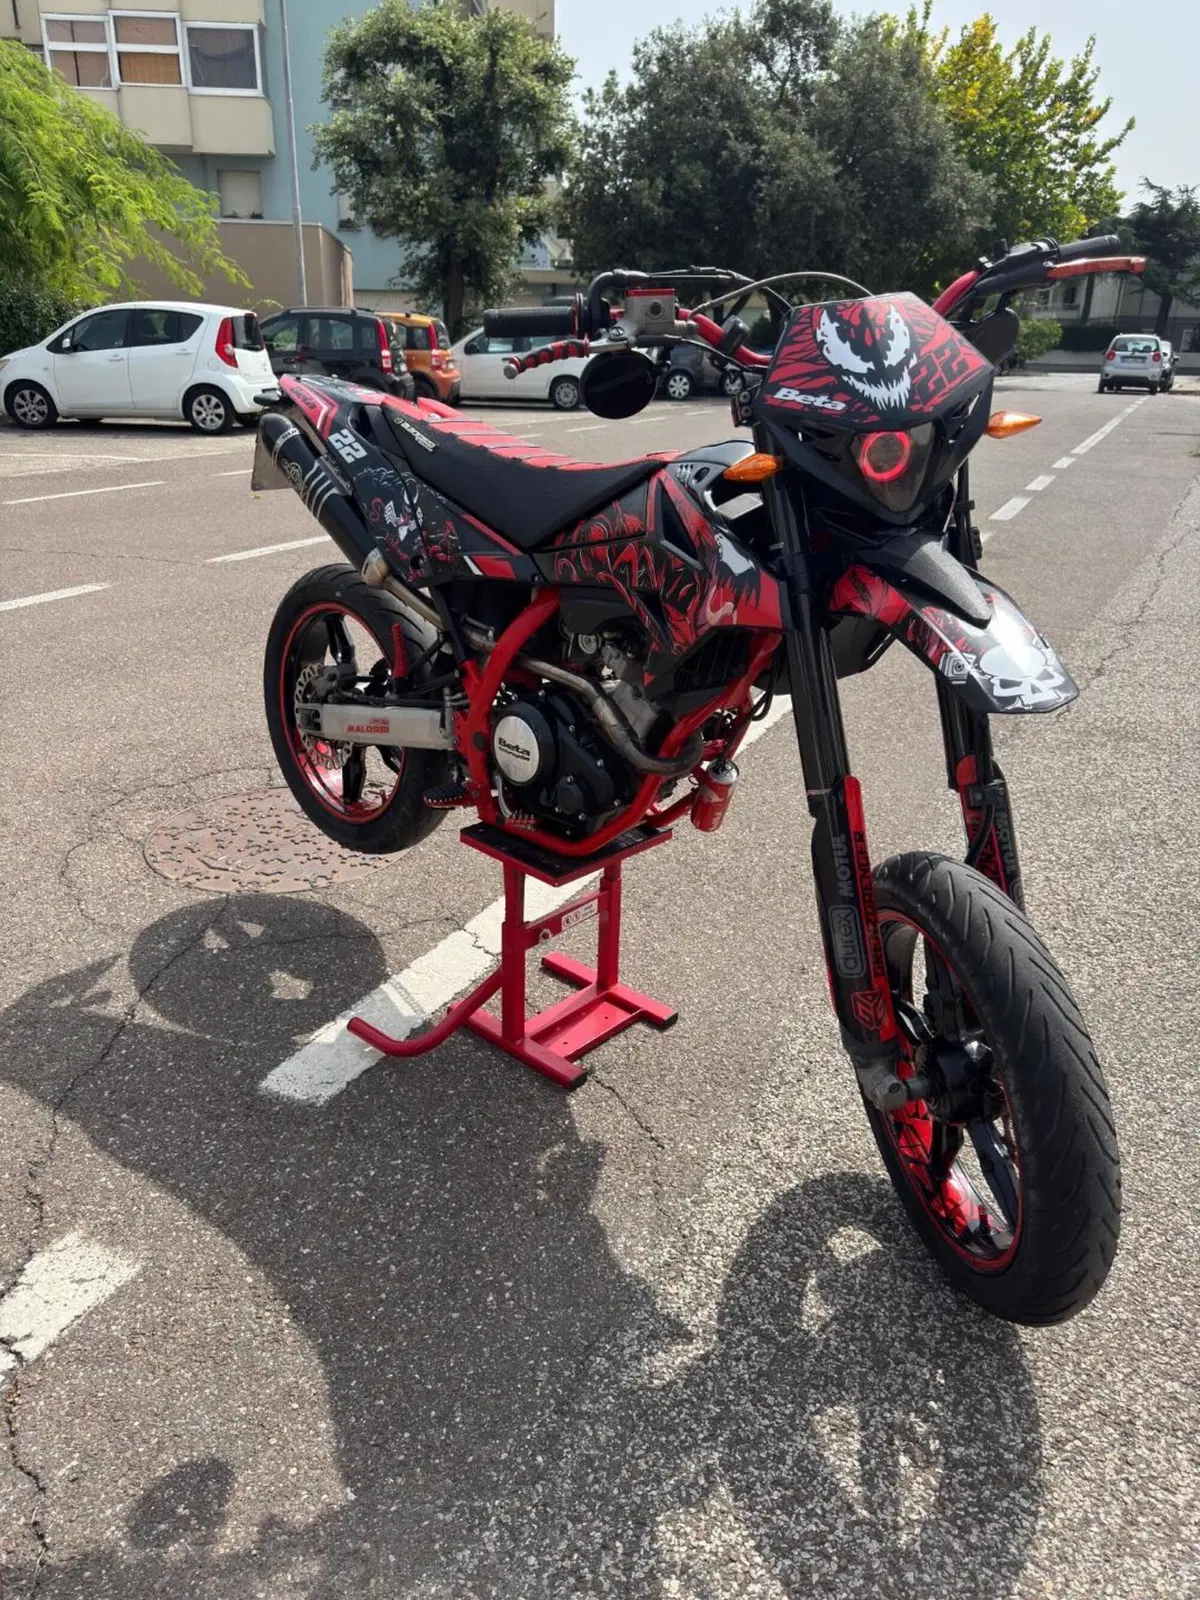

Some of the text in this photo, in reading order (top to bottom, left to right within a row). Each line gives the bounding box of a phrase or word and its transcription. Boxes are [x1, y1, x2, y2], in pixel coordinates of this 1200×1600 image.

[909, 339, 970, 401] 22
[773, 387, 848, 411] Beta
[328, 428, 368, 463] 22
[345, 723, 390, 733] MALOSSI
[498, 737, 530, 756] Beta
[831, 833, 854, 898] MOTUL
[836, 909, 858, 971] durex
